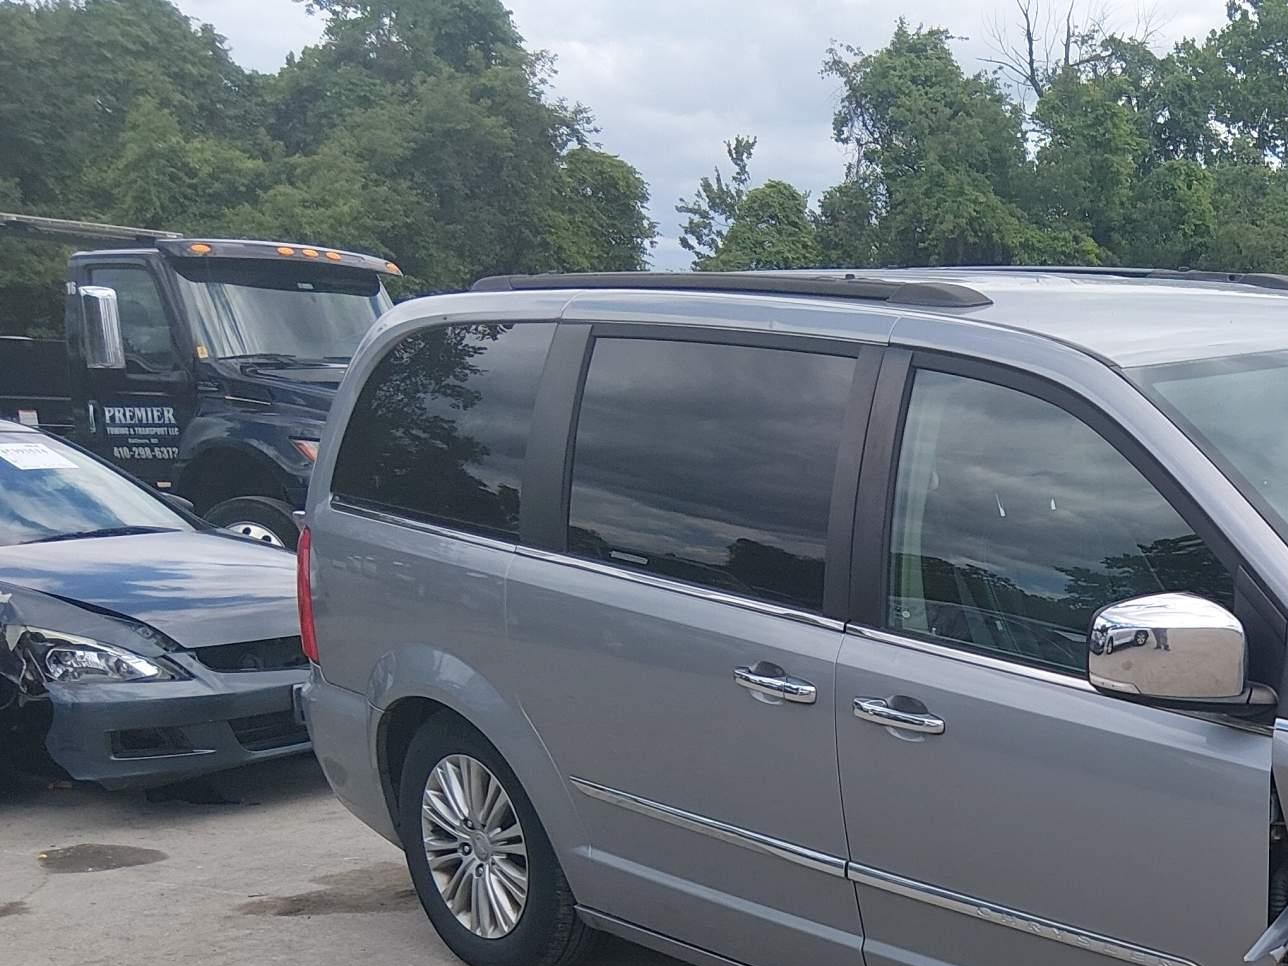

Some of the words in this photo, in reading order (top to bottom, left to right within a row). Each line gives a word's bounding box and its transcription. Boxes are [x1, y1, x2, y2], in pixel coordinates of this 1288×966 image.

[65, 281, 77, 295] 16
[104, 407, 176, 424] PREMIER
[168, 427, 179, 436] LLC
